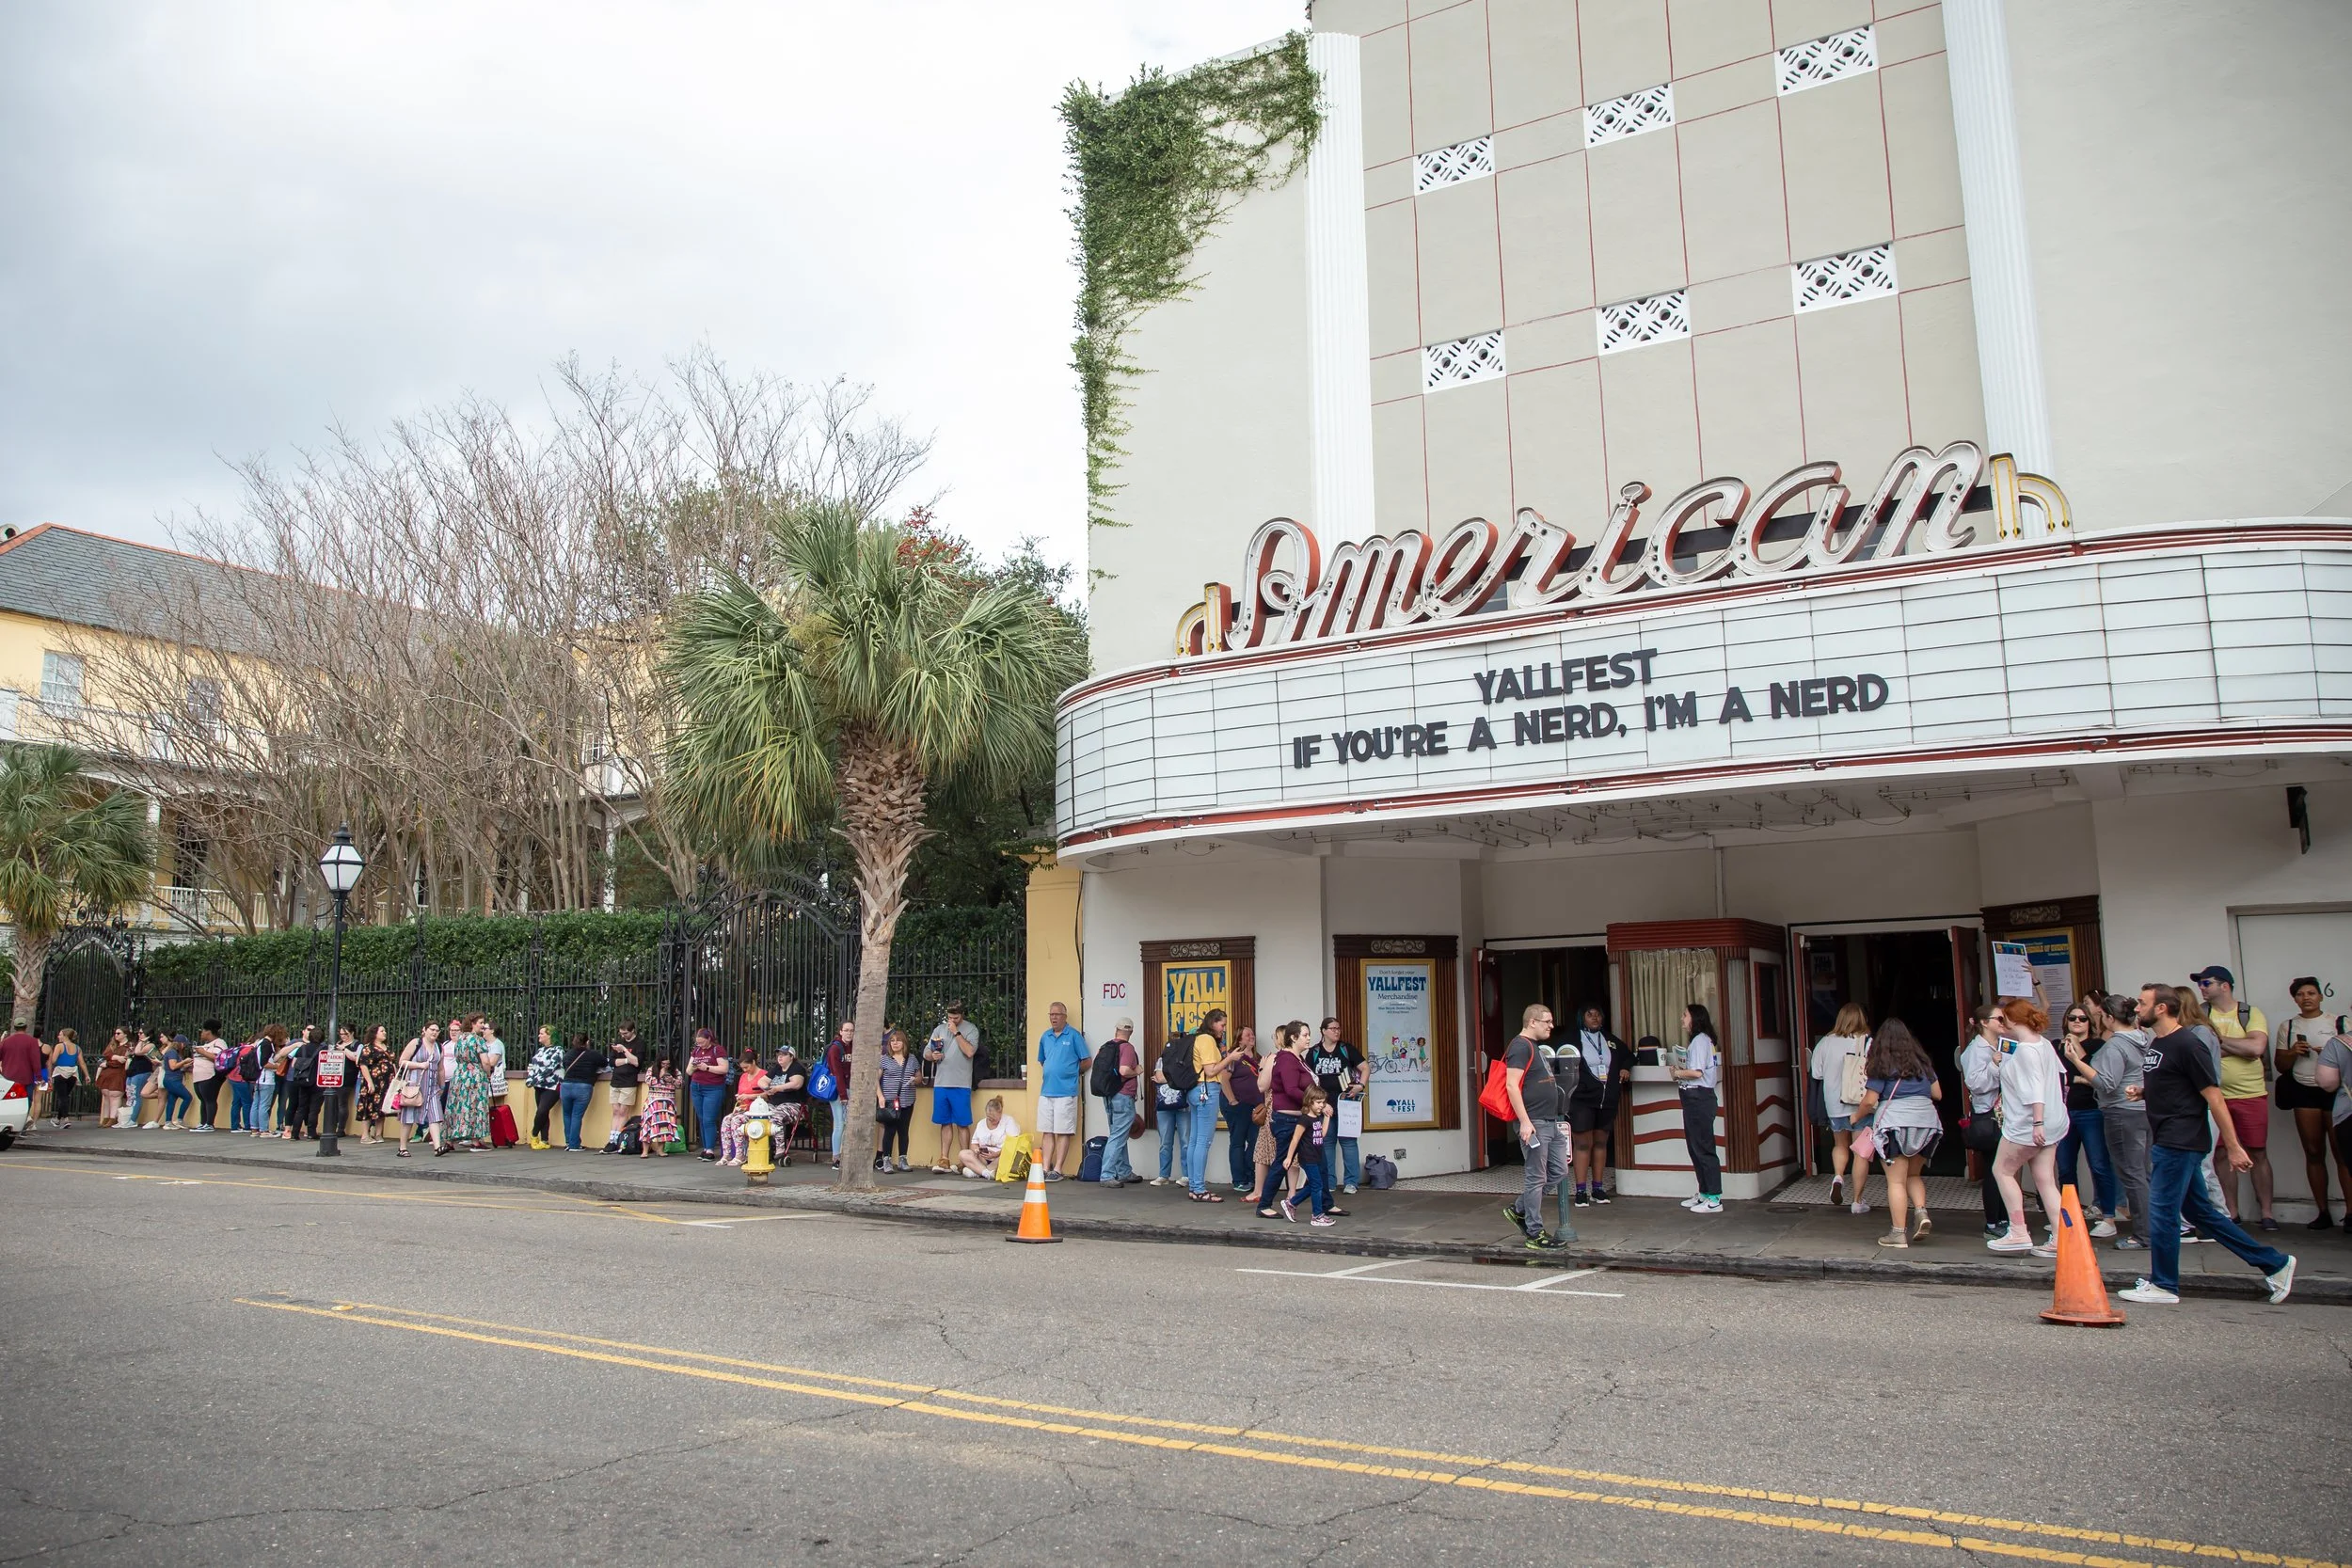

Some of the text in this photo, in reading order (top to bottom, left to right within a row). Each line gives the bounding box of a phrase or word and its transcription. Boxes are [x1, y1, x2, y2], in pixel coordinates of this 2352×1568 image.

[1225, 439, 1983, 650] American
[1473, 647, 1658, 705] YALLFEST
[1293, 673, 1890, 768] IF YOU'RE A NERD, I'M A NERD
[1103, 983, 1126, 999] FDC
[1168, 972, 1227, 1003] YALL
[1368, 976, 1426, 991] YALLFEST
[2324, 982, 2334, 998] 6
